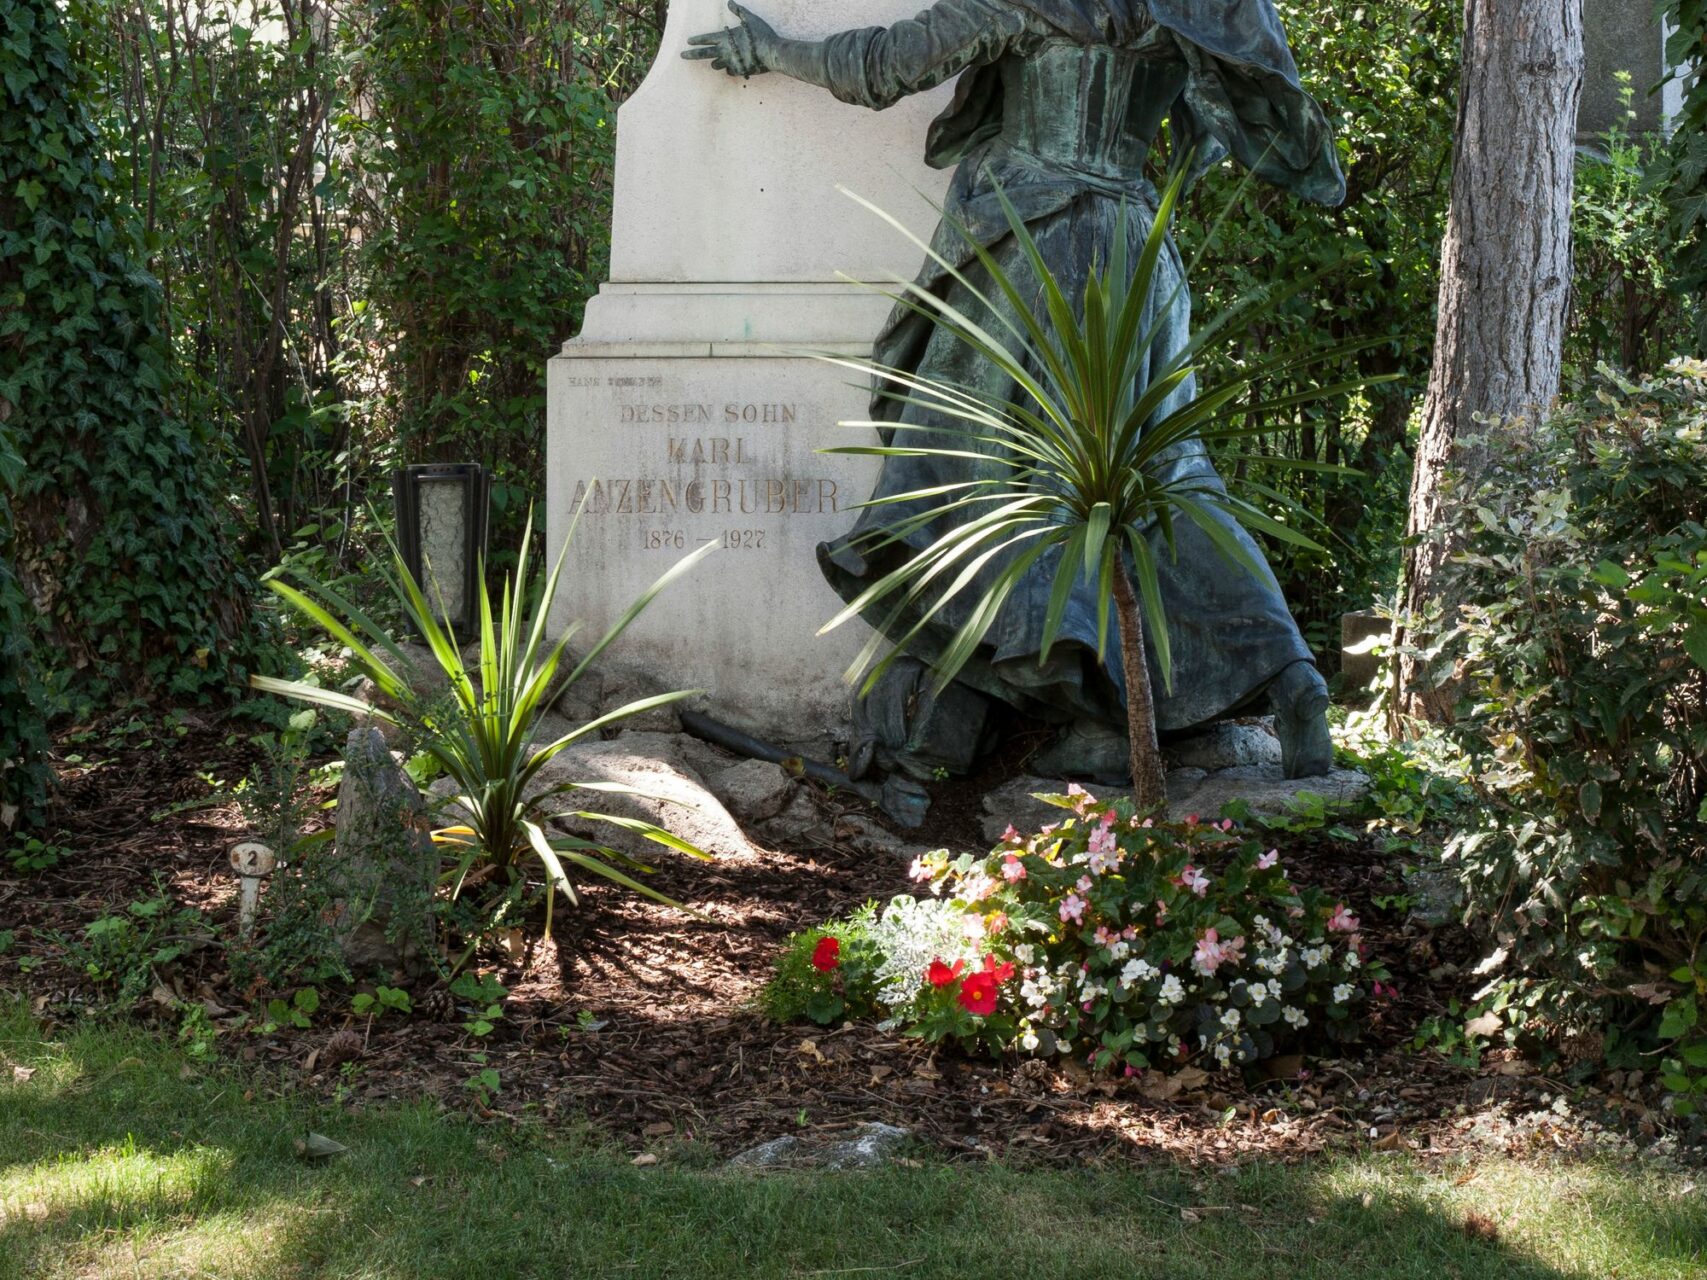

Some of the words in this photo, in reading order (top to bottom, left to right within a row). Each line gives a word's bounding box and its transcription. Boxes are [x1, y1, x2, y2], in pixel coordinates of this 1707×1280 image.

[619, 404, 713, 423] DESSEN
[724, 404, 797, 423] SOHN
[667, 437, 752, 464] KARL
[567, 478, 840, 514] ANZENGRUBER
[643, 529, 685, 550] 1876
[247, 850, 258, 866] 2
